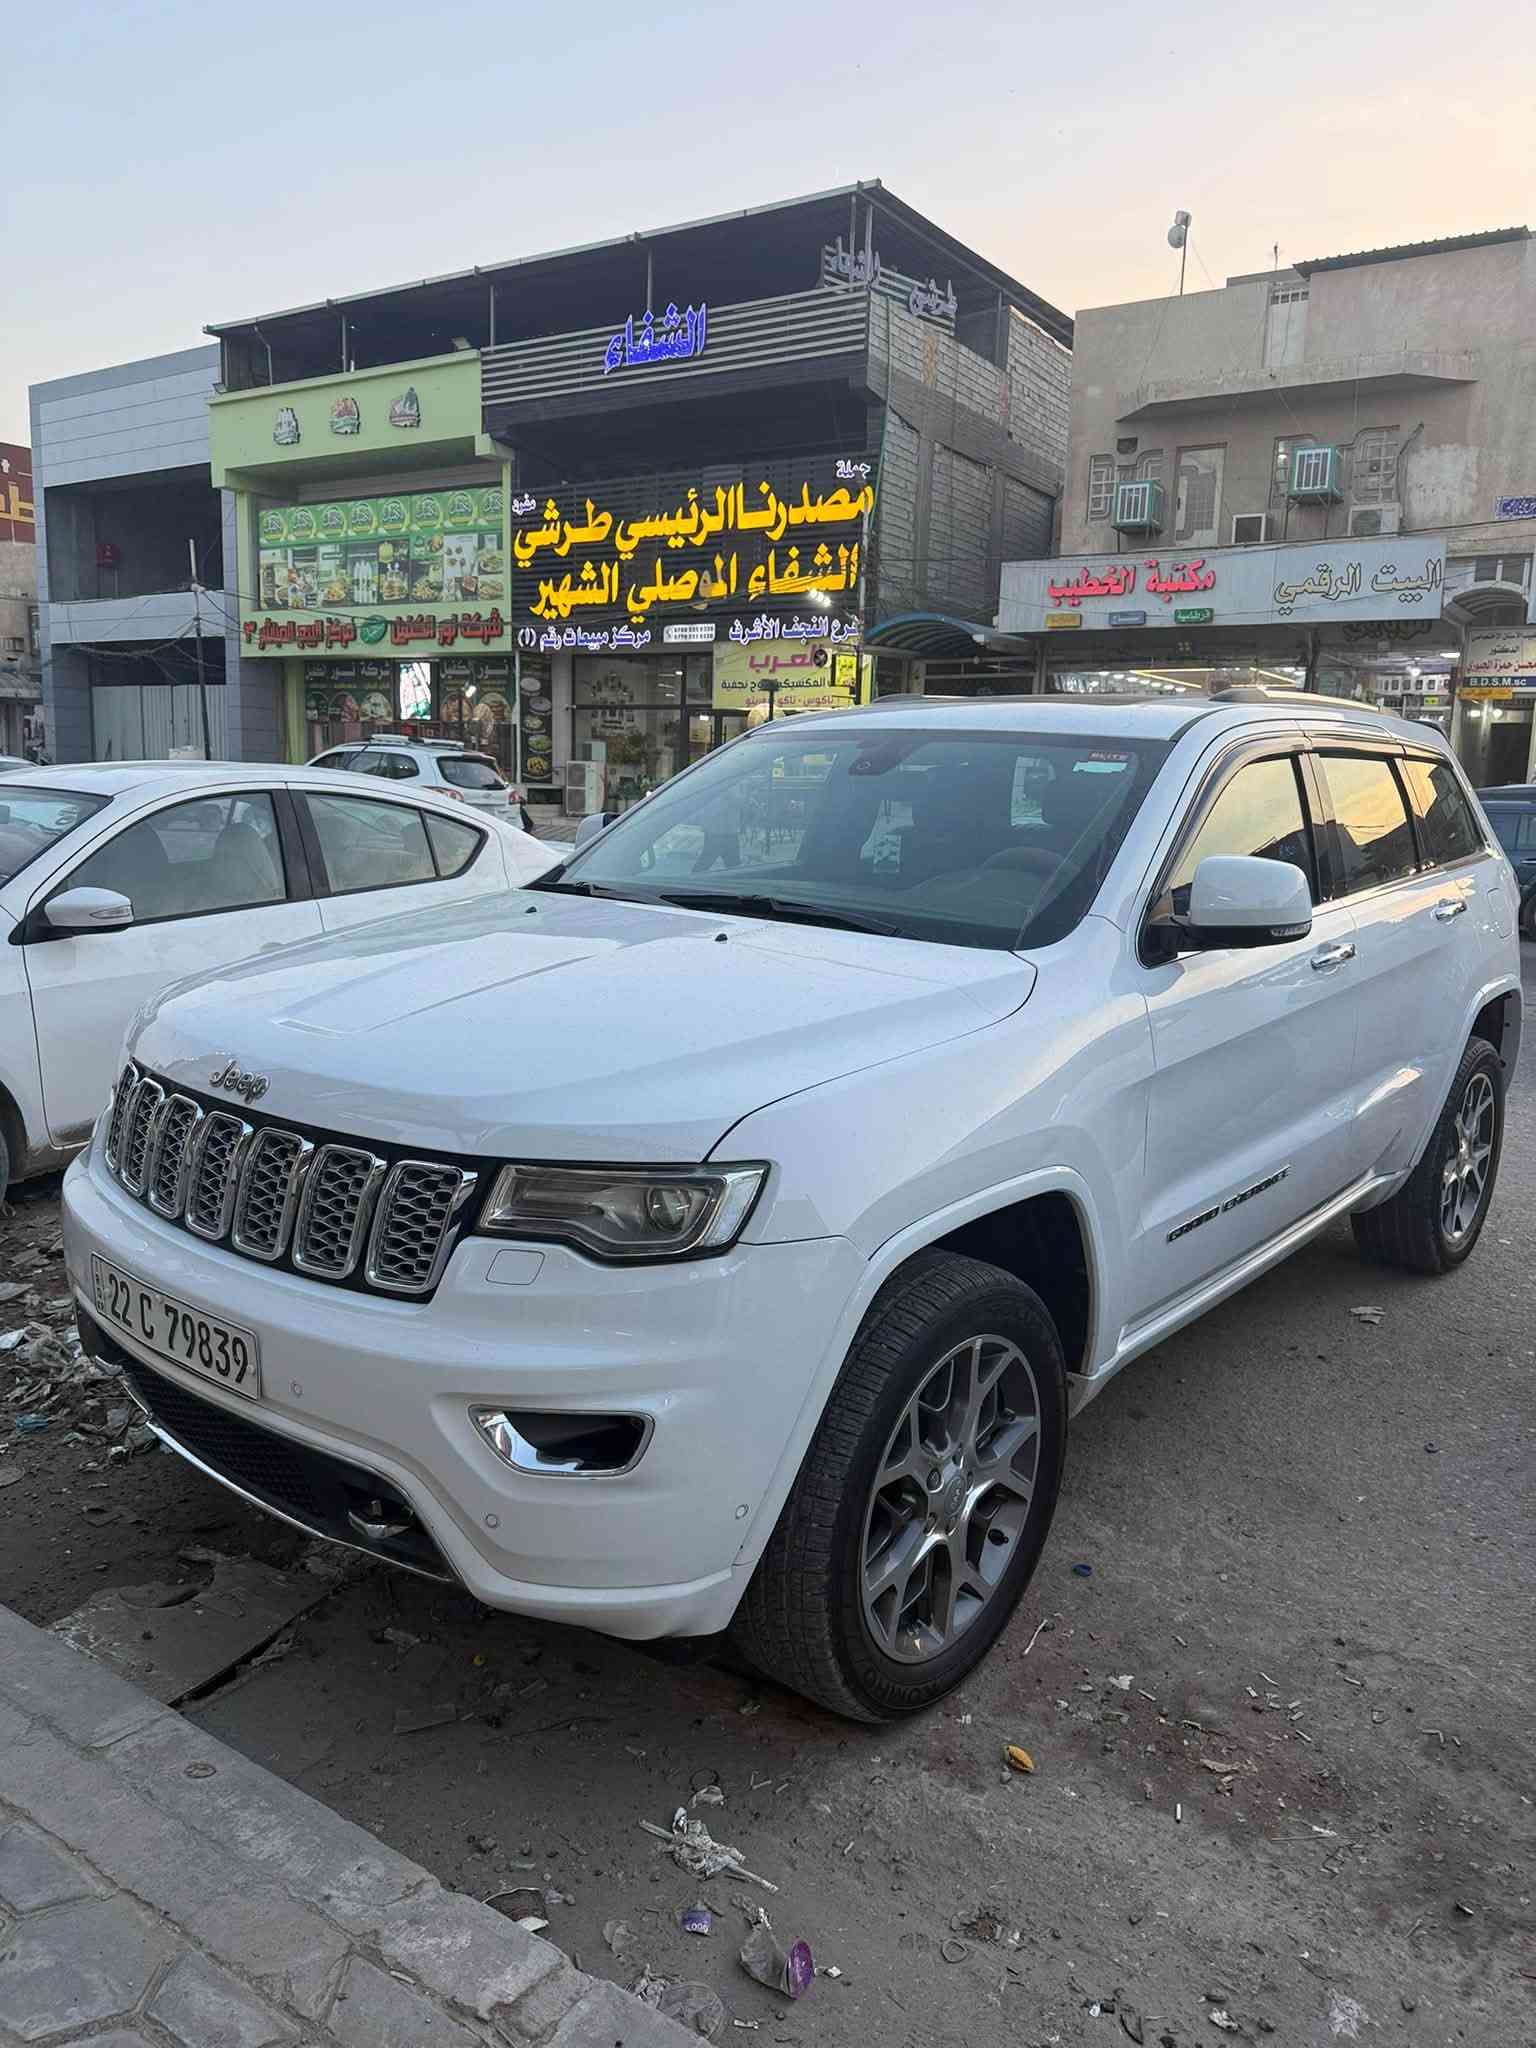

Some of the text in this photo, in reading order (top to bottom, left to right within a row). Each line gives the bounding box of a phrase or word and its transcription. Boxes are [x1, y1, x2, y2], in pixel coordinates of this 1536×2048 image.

[604, 302, 706, 375] الشفاء
[514, 498, 613, 568] طرشي
[615, 485, 735, 561] الرئيسي
[737, 481, 874, 541] مصدرنا
[530, 543, 859, 623] الشفاء الموصلي الشهير
[1048, 559, 1216, 607] مكتبة الخطيب
[1273, 559, 1442, 616] البيت الرقمي
[437, 613, 459, 646] نور
[460, 608, 504, 645] شركة
[539, 626, 562, 653] رقم
[563, 627, 609, 651] مبيعات
[610, 625, 651, 649] مركز
[729, 614, 780, 645] الأشرف
[781, 616, 829, 644] النجف
[209, 1059, 271, 1105] Jeep
[109, 1273, 133, 1328] 22
[140, 1292, 154, 1340] C
[164, 1303, 249, 1384] 79839
